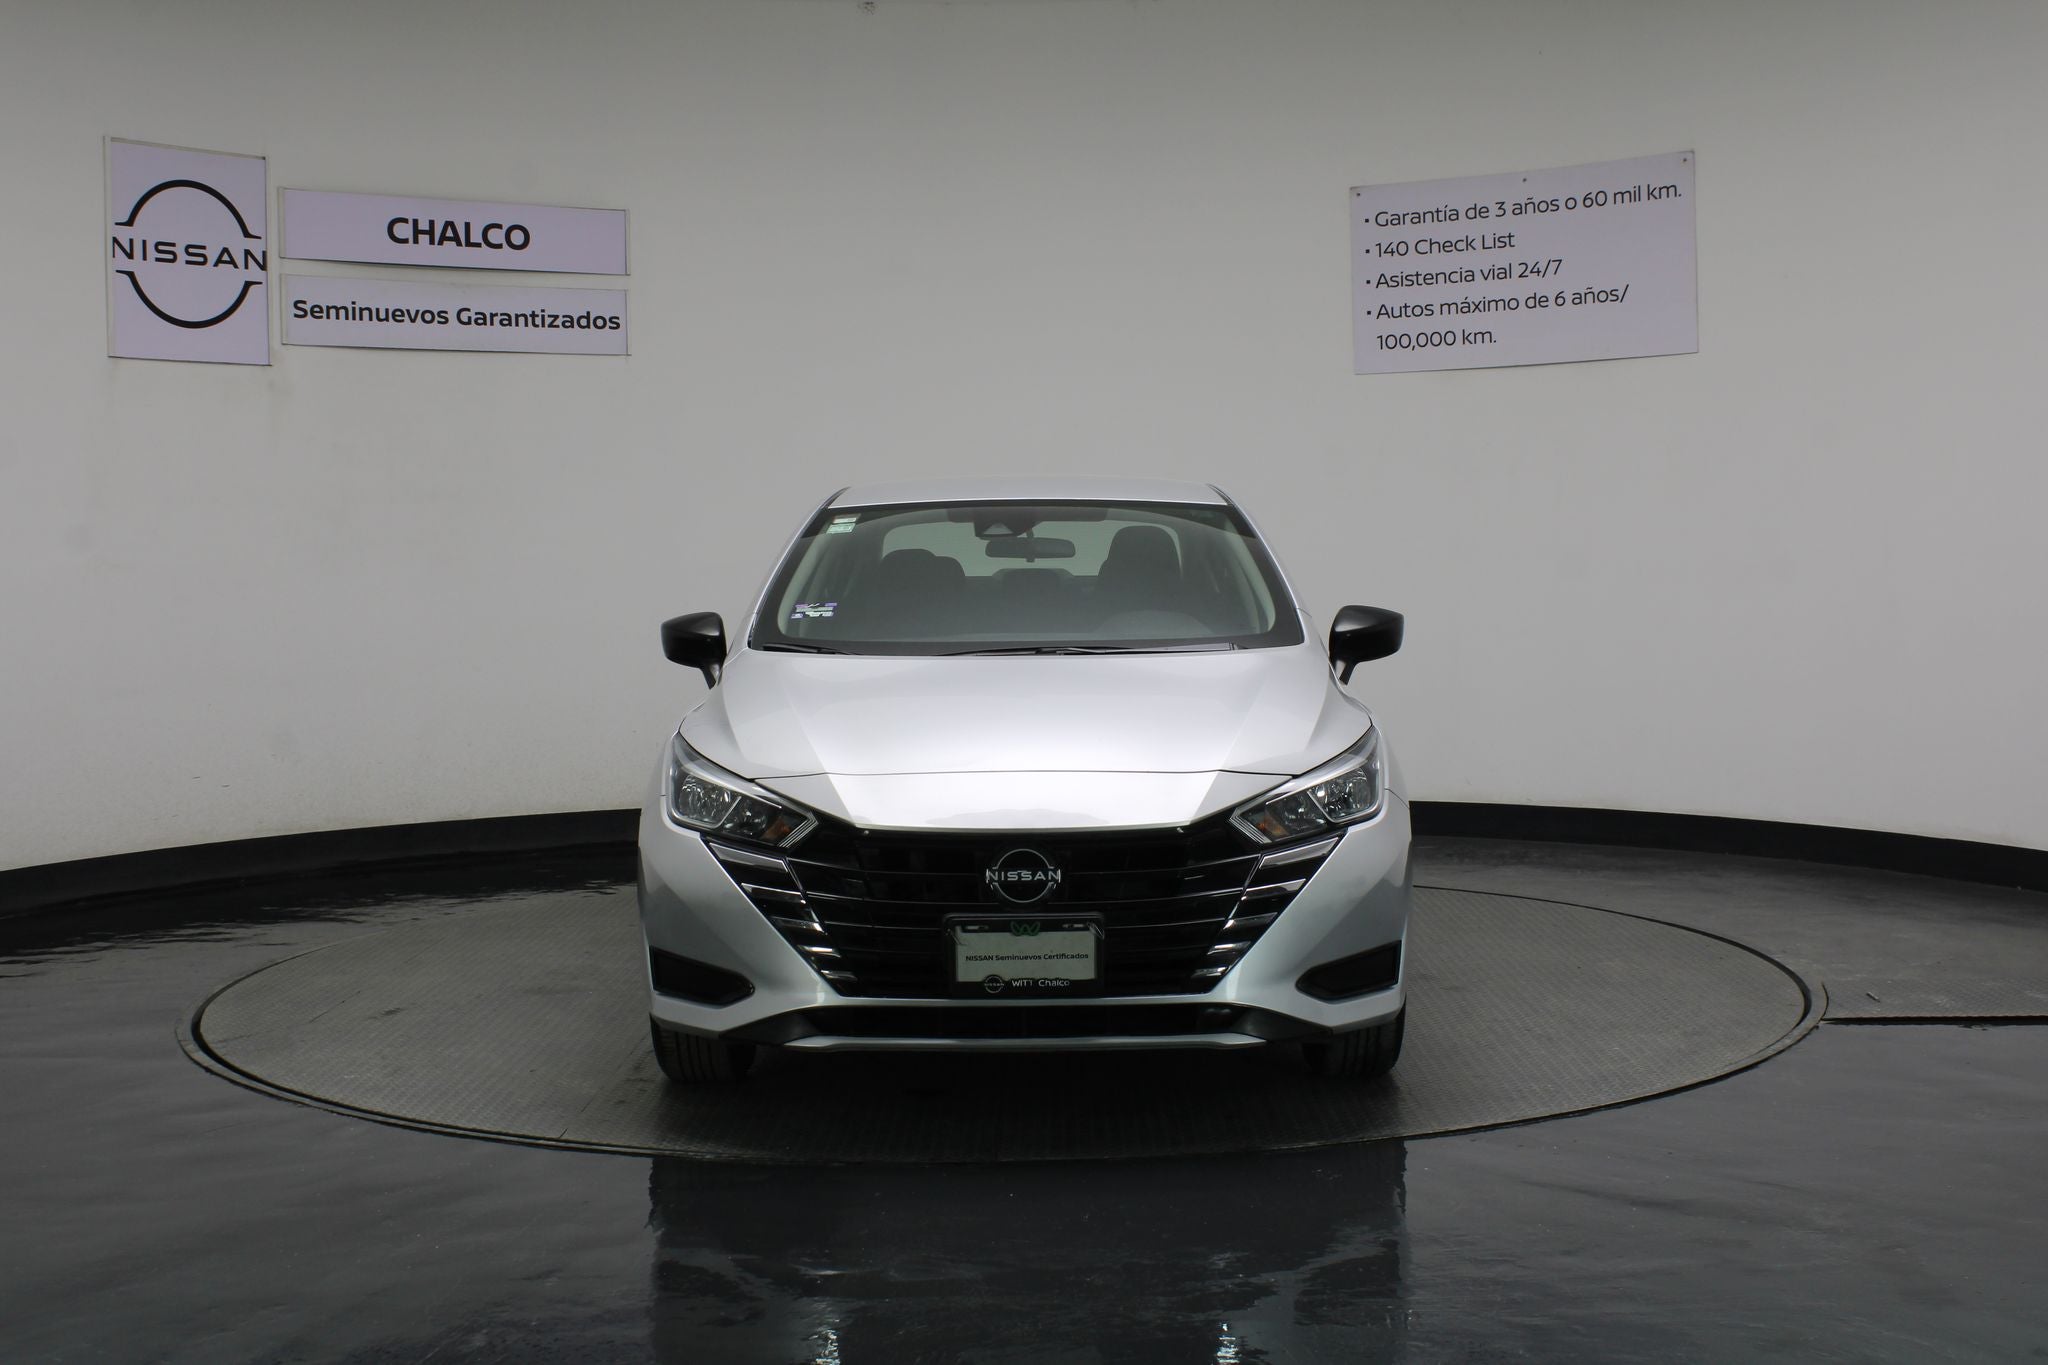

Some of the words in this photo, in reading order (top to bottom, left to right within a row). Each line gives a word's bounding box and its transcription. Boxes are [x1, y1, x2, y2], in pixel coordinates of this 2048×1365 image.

[1374, 203, 1460, 228] Garantía
[1465, 202, 1490, 220] de
[1494, 200, 1507, 218] 3
[1511, 197, 1560, 216] años
[1564, 196, 1578, 211] o
[1582, 190, 1608, 209] 60
[1613, 184, 1642, 205] mil
[1646, 183, 1682, 201] km.
[386, 216, 531, 251] CHALCO
[1375, 241, 1409, 258] 140
[1414, 234, 1477, 256] Check
[1481, 232, 1516, 250] List
[111, 236, 268, 272] NISSAN
[1375, 267, 1476, 289] Asistencia
[1479, 262, 1513, 282] vial
[1517, 258, 1563, 279] 24/7
[293, 299, 450, 326] Seminuevos
[455, 307, 621, 331] Garantizados
[1375, 303, 1435, 320] Autos
[1439, 296, 1520, 317] máximo
[1524, 292, 1550, 310] de
[1554, 290, 1566, 307] 6
[1571, 283, 1630, 306] años/
[1376, 330, 1457, 352] 100,000
[1461, 328, 1498, 346] km.
[986, 869, 1061, 883] NISSAN
[995, 953, 1042, 962] Seminuevos
[1043, 952, 1089, 961] Certificados
[1038, 978, 1070, 987] Chalco
